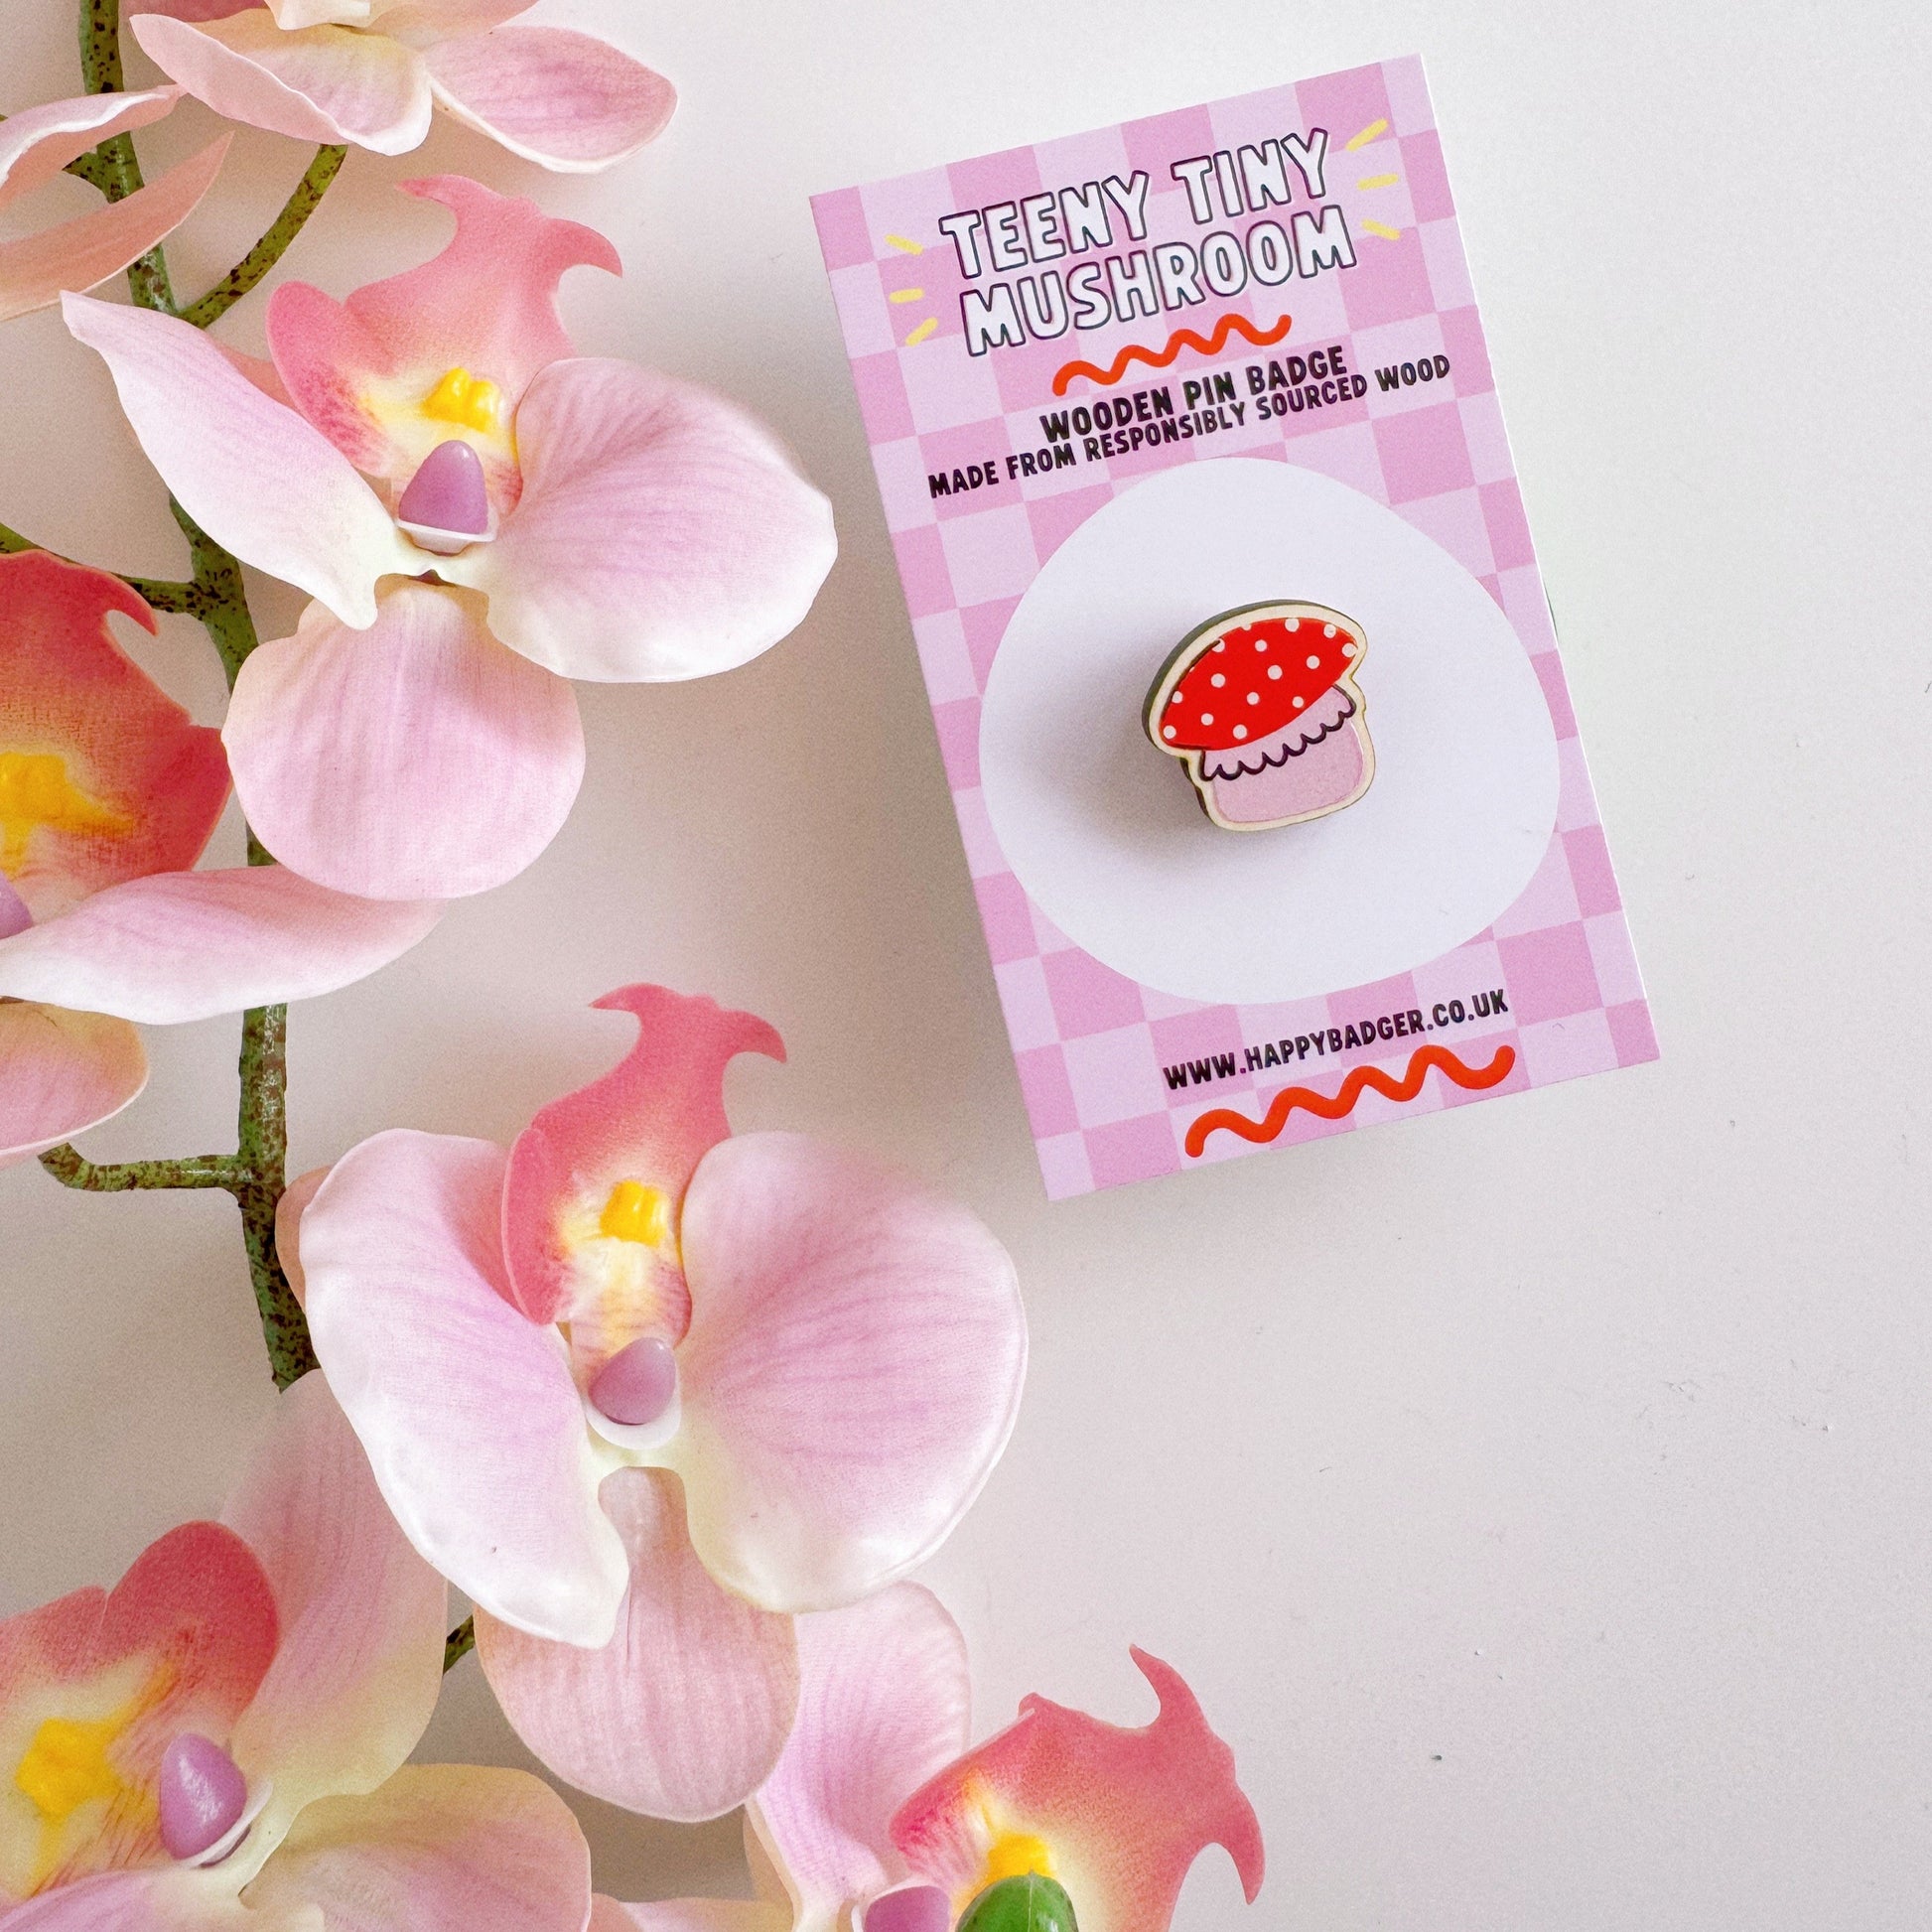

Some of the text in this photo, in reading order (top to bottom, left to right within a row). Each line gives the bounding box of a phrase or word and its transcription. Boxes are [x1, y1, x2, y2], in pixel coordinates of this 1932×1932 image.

[938, 128, 1329, 279] TEENY TINY
[959, 205, 1357, 357] MUSHROOM
[928, 354, 1450, 498] MADE FROM RESPONSIBLY SOURCED WOOD
[1039, 345, 1347, 443] WOODEN PIN BADGE
[1163, 989, 1509, 1090] WWW.HAPPYBADGER.CO.UK
